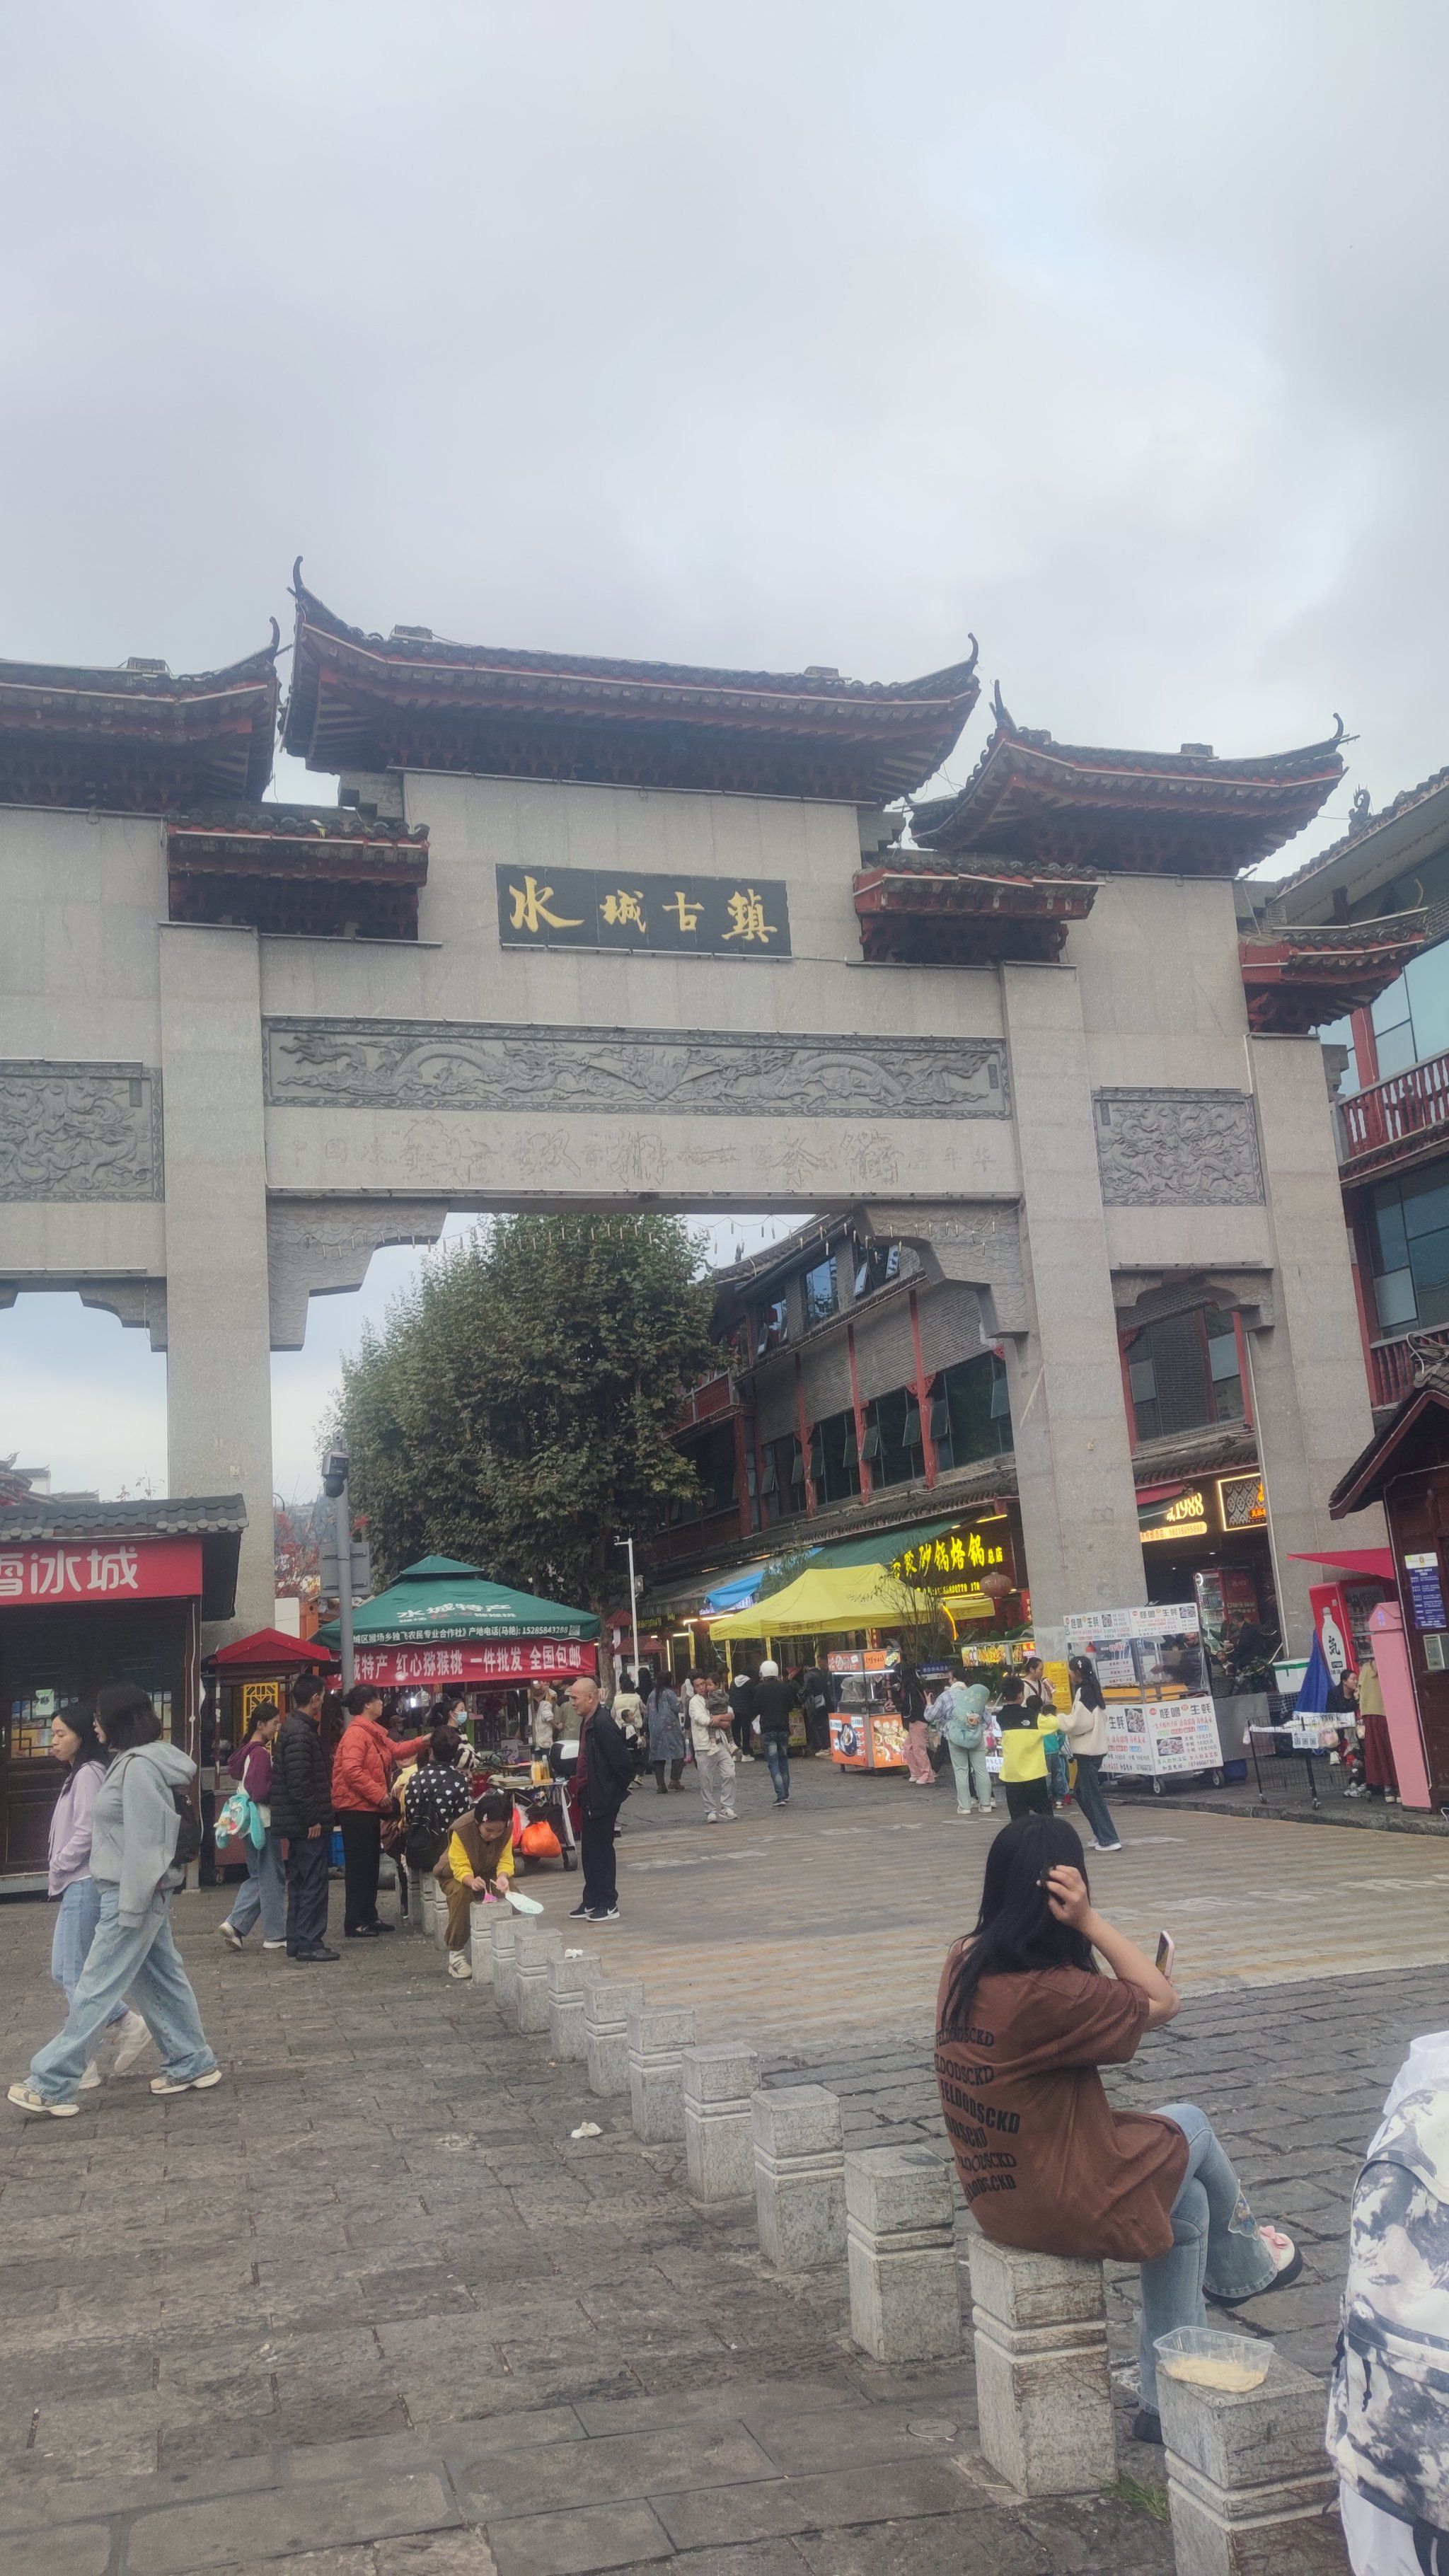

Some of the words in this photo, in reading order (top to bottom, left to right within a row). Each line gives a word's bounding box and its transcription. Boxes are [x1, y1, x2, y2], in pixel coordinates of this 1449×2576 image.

[396, 1649, 463, 1677] 红心猕猴桃
[470, 1646, 523, 1673] 一件批发
[529, 1644, 582, 1670] 全国包邮
